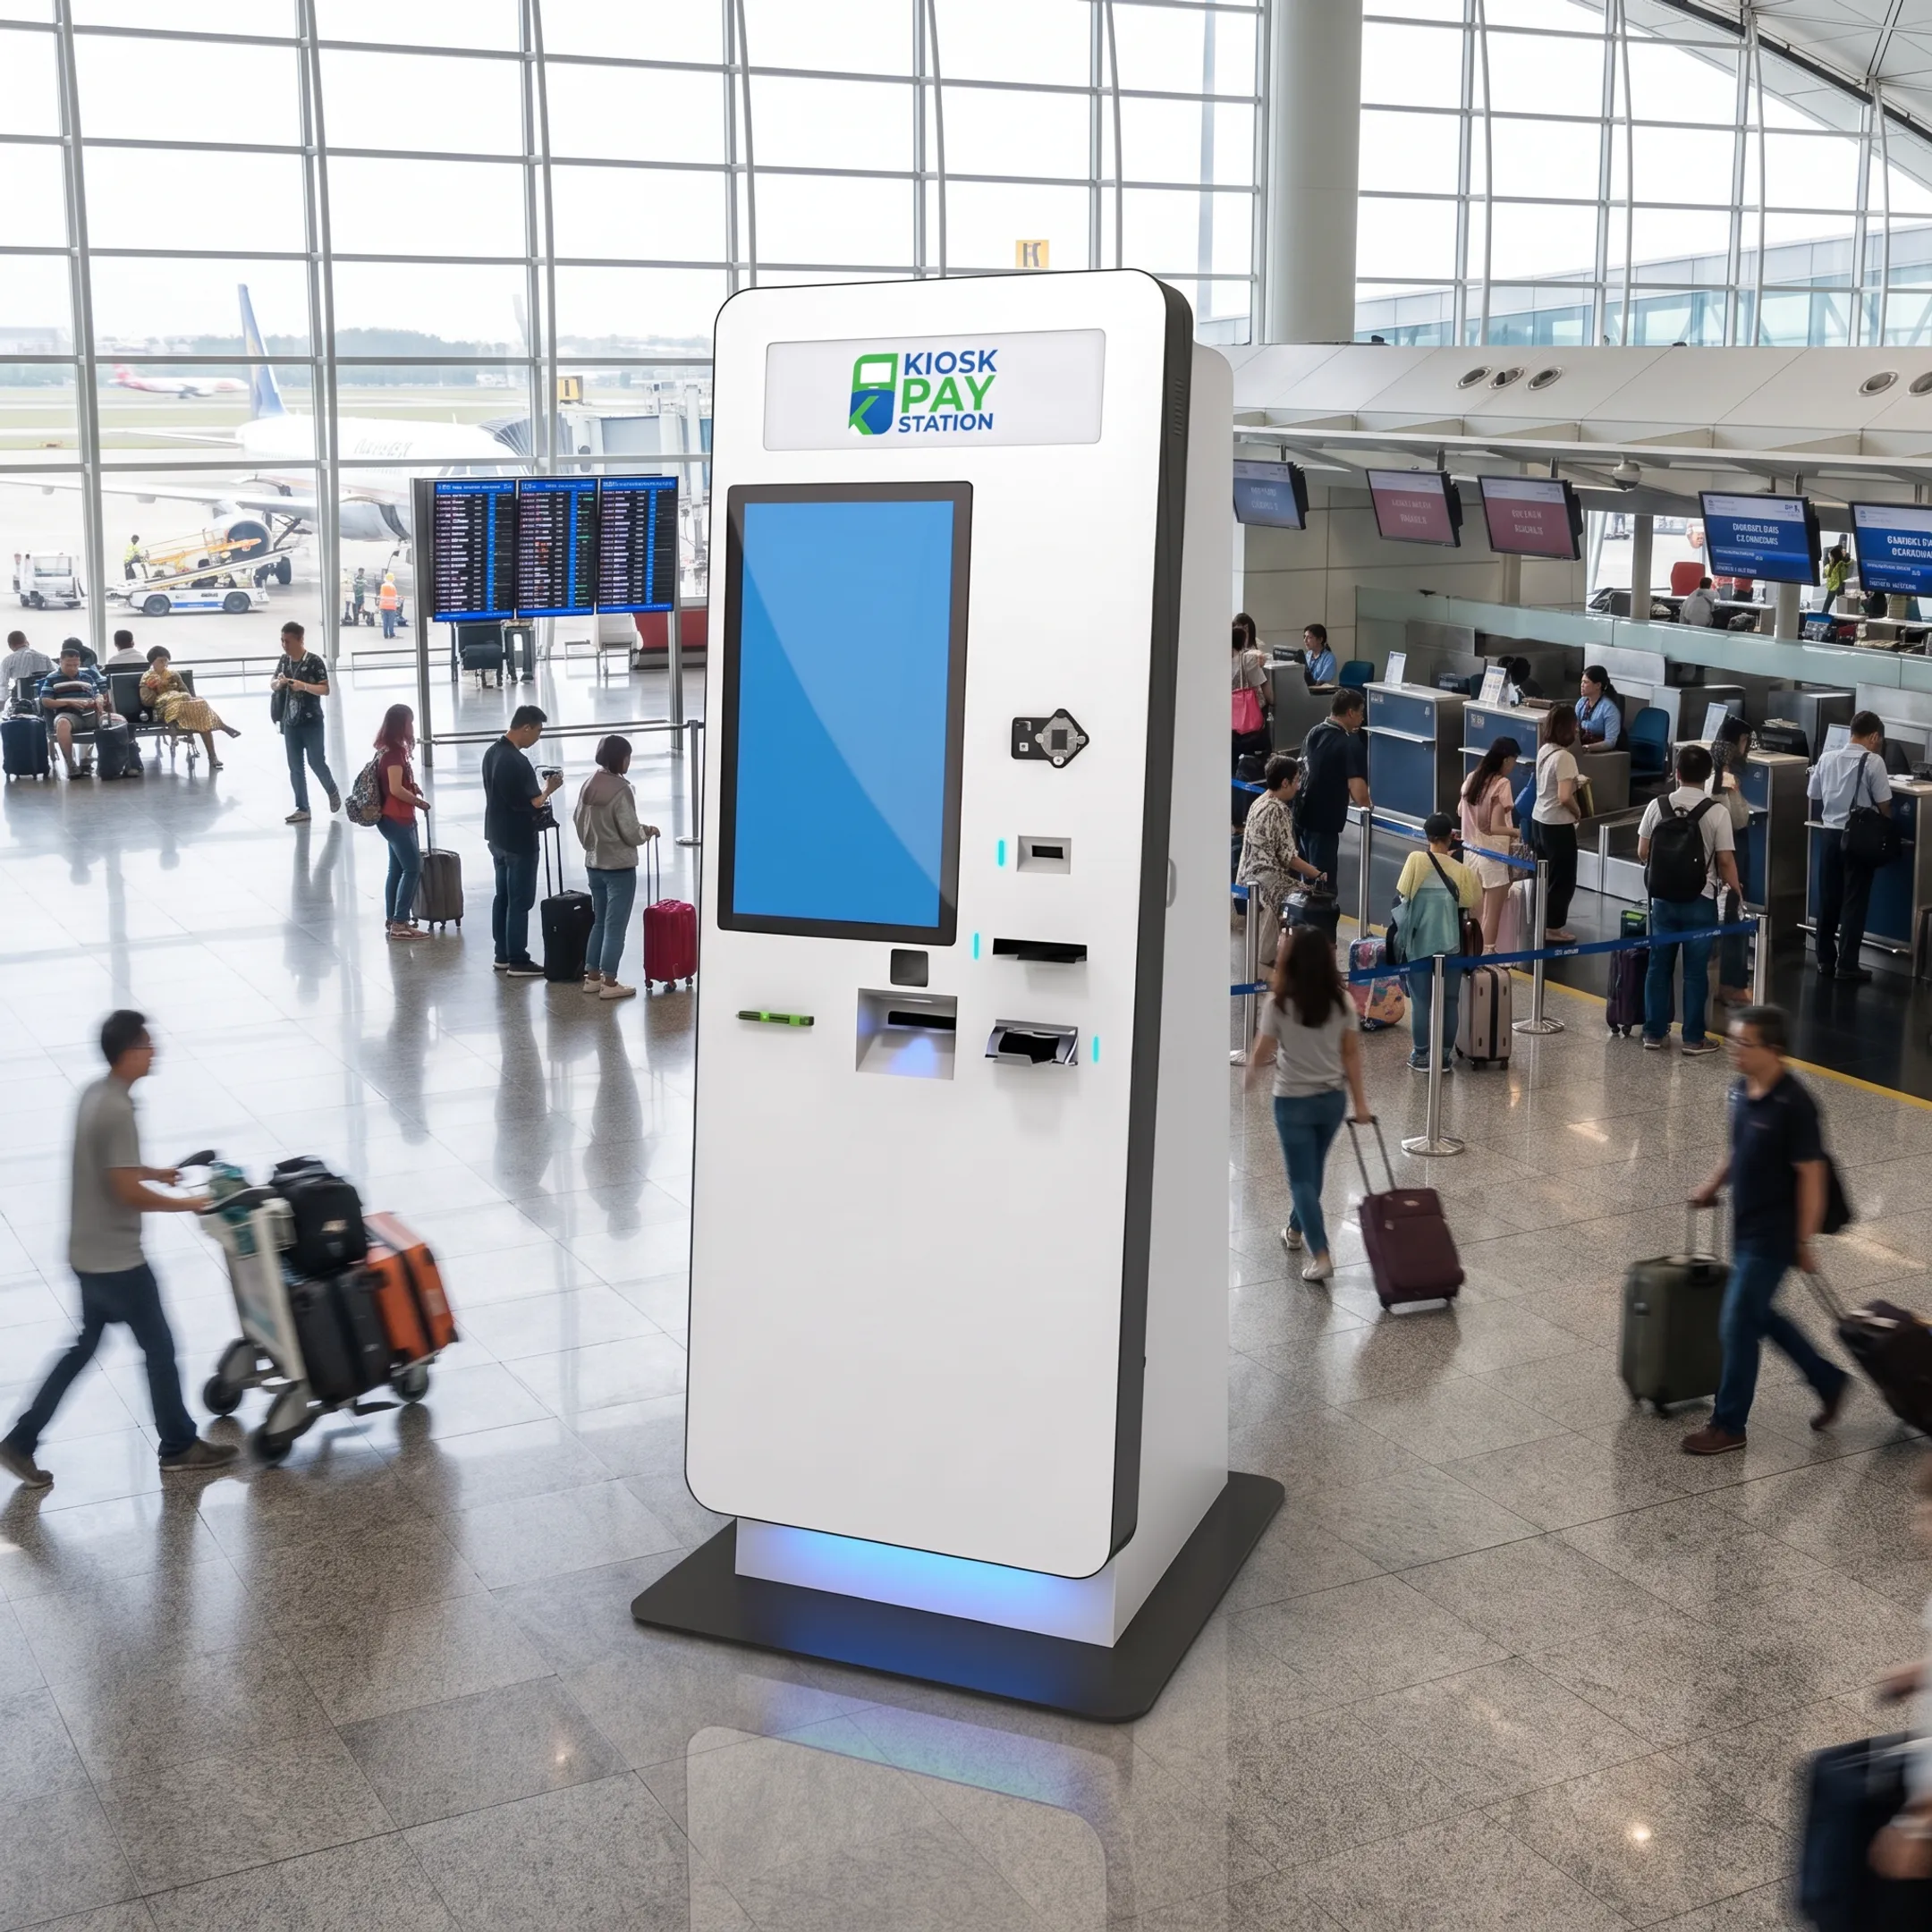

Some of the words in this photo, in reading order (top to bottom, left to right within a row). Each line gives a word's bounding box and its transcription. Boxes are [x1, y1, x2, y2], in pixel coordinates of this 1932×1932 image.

[903, 349, 998, 376] KIOSK
[901, 374, 996, 413] PAY
[898, 412, 994, 434] STATION
